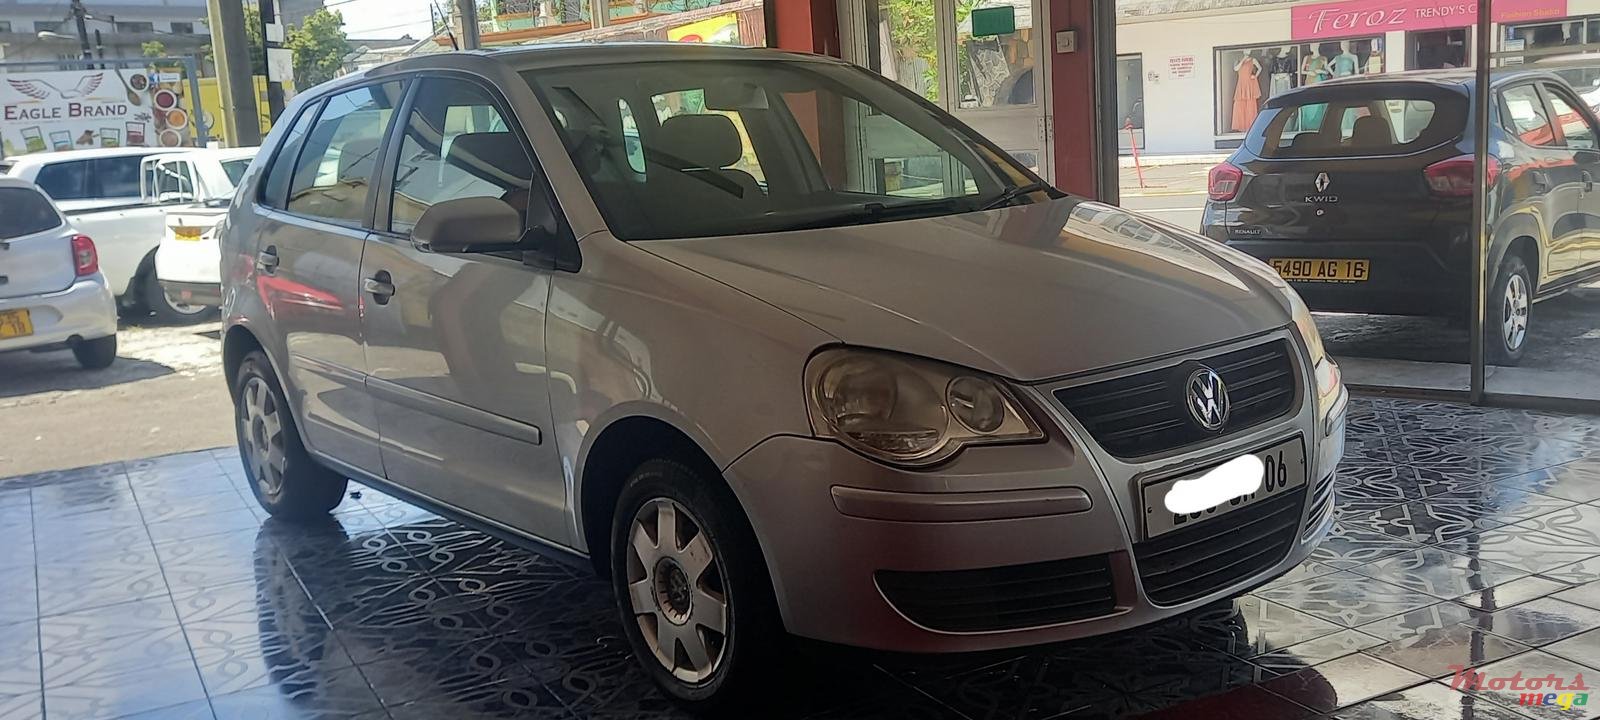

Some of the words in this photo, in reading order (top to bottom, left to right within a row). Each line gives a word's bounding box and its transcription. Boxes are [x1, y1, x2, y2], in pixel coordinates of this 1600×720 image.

[1308, 8, 1407, 34] Feroz
[1415, 5, 1465, 18] TRENDY'S
[4, 105, 62, 121] EAGLE
[68, 102, 128, 118] BRAND
[1304, 195, 1339, 203] KWID
[1273, 260, 1312, 277] 5490
[1317, 261, 1337, 278] AG
[1346, 261, 1365, 278] 16
[1264, 450, 1287, 493] 06
